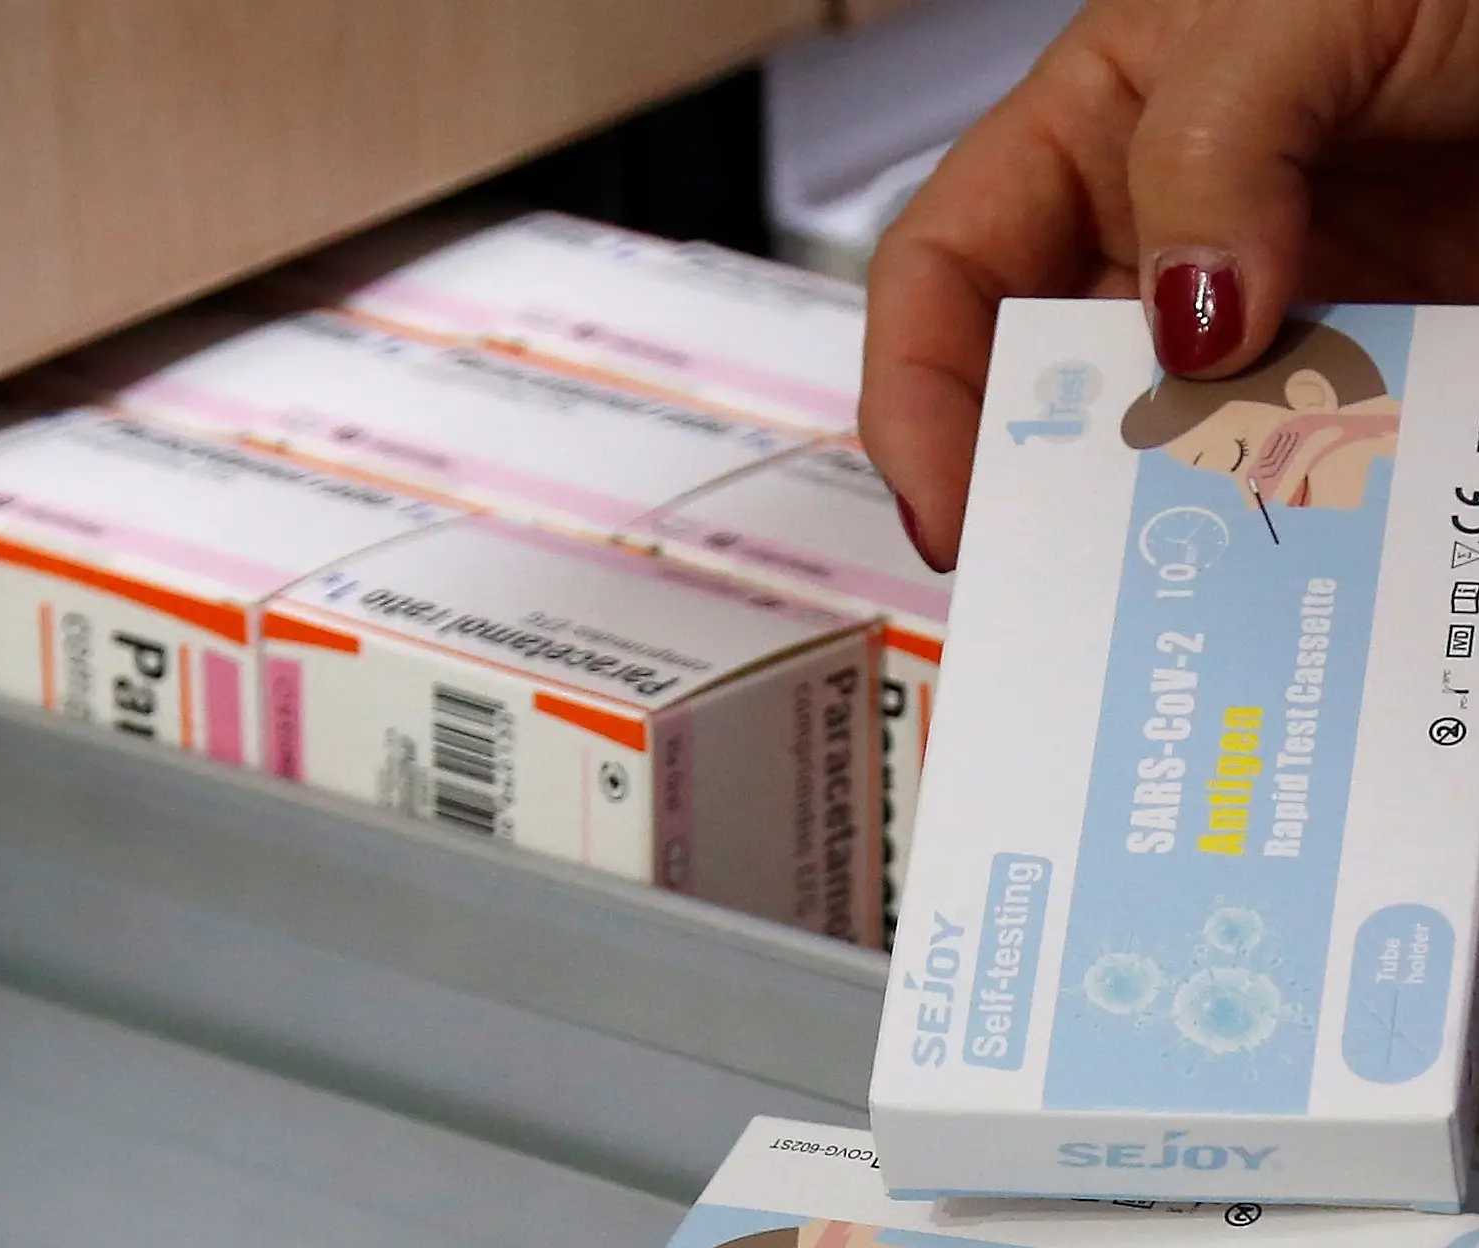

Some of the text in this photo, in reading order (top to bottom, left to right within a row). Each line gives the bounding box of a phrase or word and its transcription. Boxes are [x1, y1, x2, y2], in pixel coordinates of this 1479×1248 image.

[439, 612, 681, 698] Paracetamol
[1453, 630, 1469, 651] IVD
[1125, 631, 1205, 855] SARS-CoV-2
[1263, 577, 1338, 858] Rapid Test Cassette
[1197, 705, 1264, 857] Antigen
[971, 860, 1044, 1059] Self-testing
[1375, 936, 1402, 984] Tube
[1402, 923, 1430, 985] holder
[769, 1137, 874, 1163] COVG-602ST
